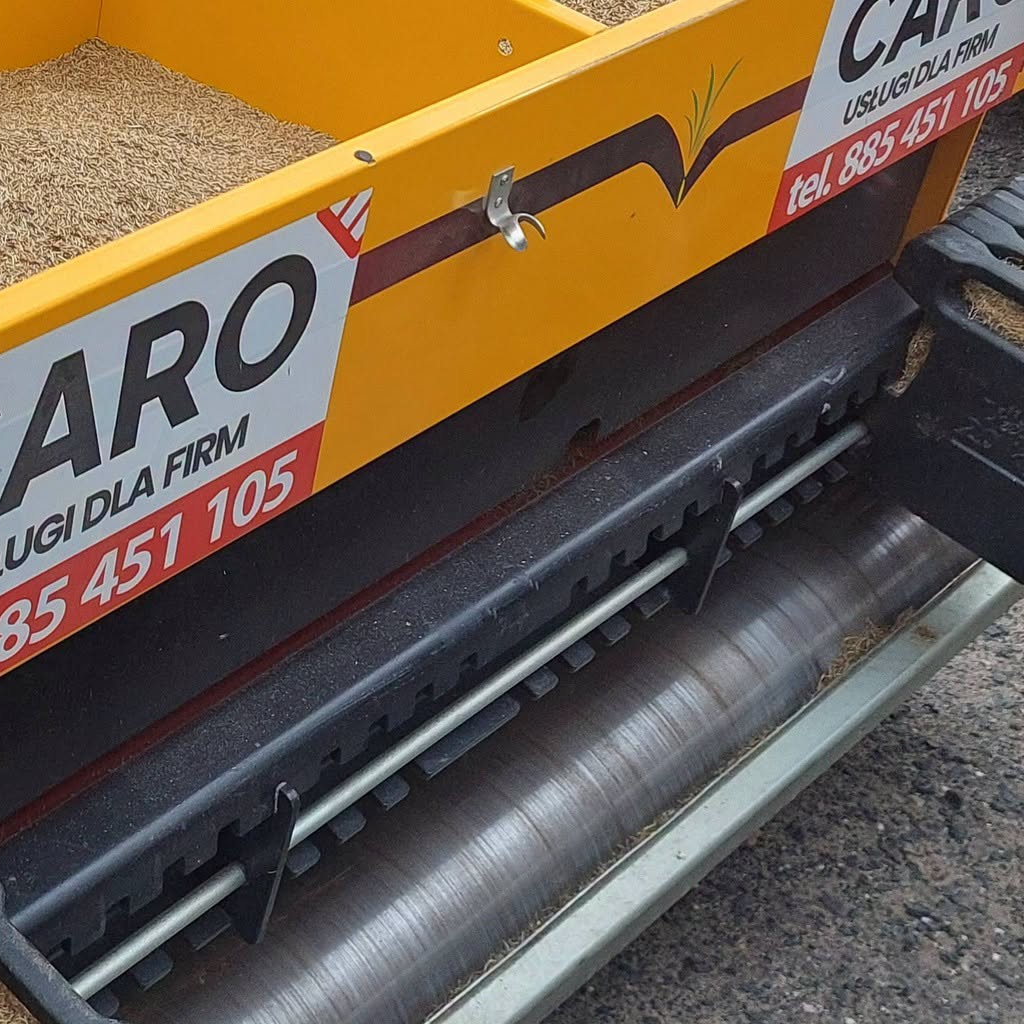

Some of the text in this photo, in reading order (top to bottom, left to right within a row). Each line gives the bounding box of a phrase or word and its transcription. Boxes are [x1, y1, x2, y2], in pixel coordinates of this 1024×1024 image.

[786, 57, 1014, 216] tel. 885 451 105
[843, 24, 1000, 126] USŁUGI DLA FIRM
[80, 513, 183, 607] 451
[205, 449, 299, 543] 105
[81, 465, 154, 531] DLA
[163, 413, 249, 488] FIRM
